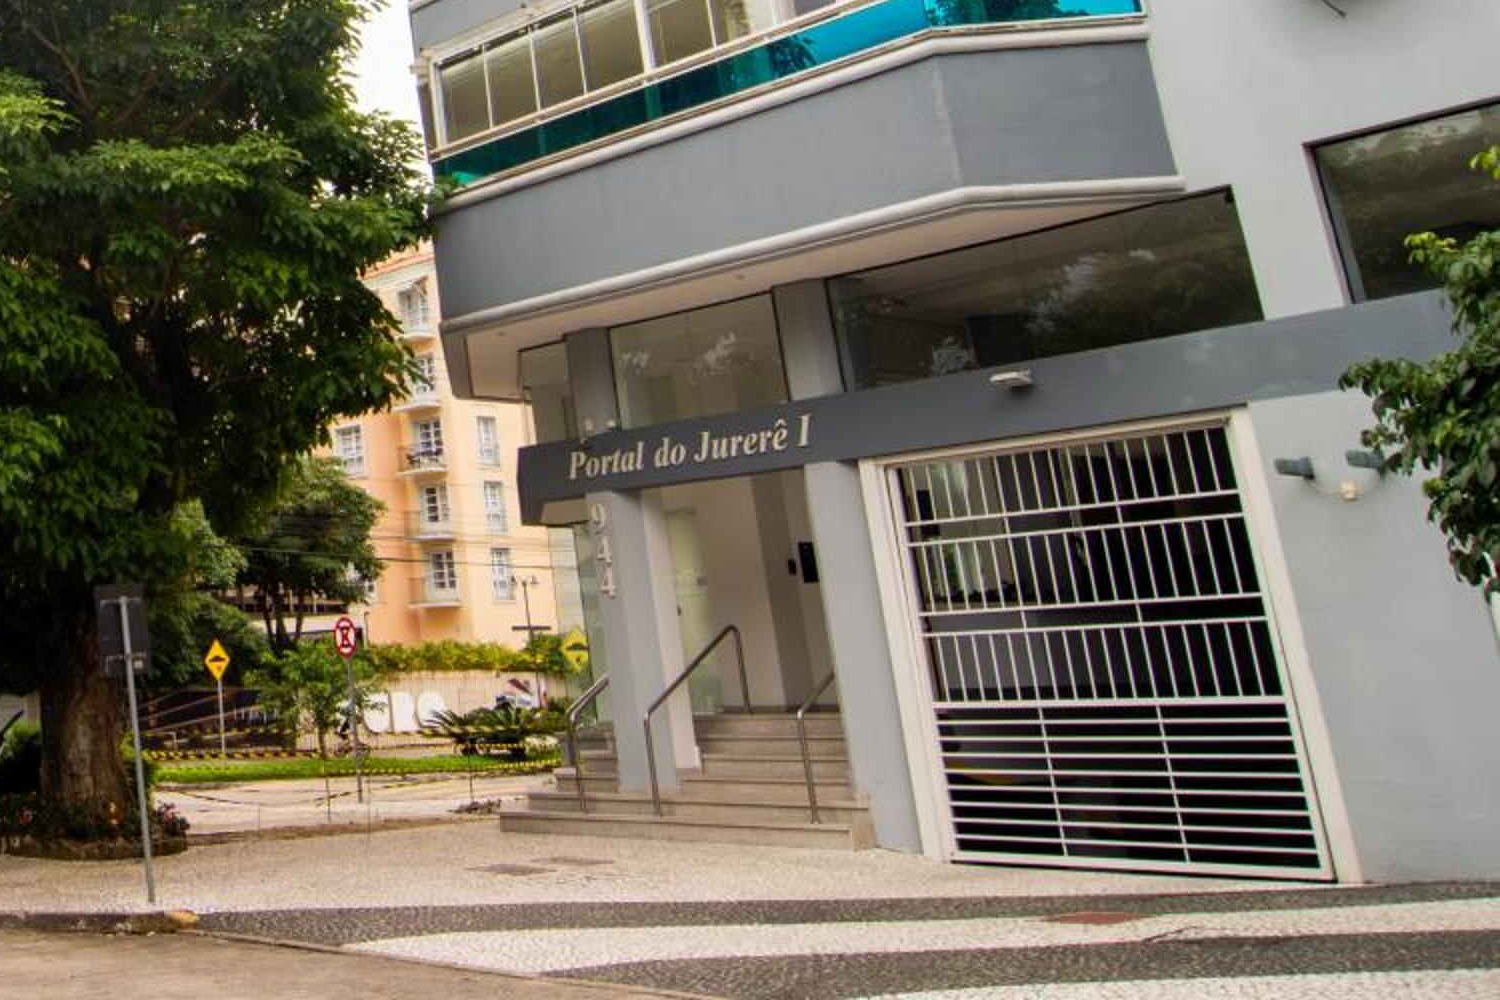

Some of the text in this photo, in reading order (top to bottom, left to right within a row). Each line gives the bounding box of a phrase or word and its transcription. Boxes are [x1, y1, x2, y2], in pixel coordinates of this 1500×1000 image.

[568, 442, 644, 480] Portal
[654, 439, 685, 468] do
[694, 419, 788, 463] Jurerê
